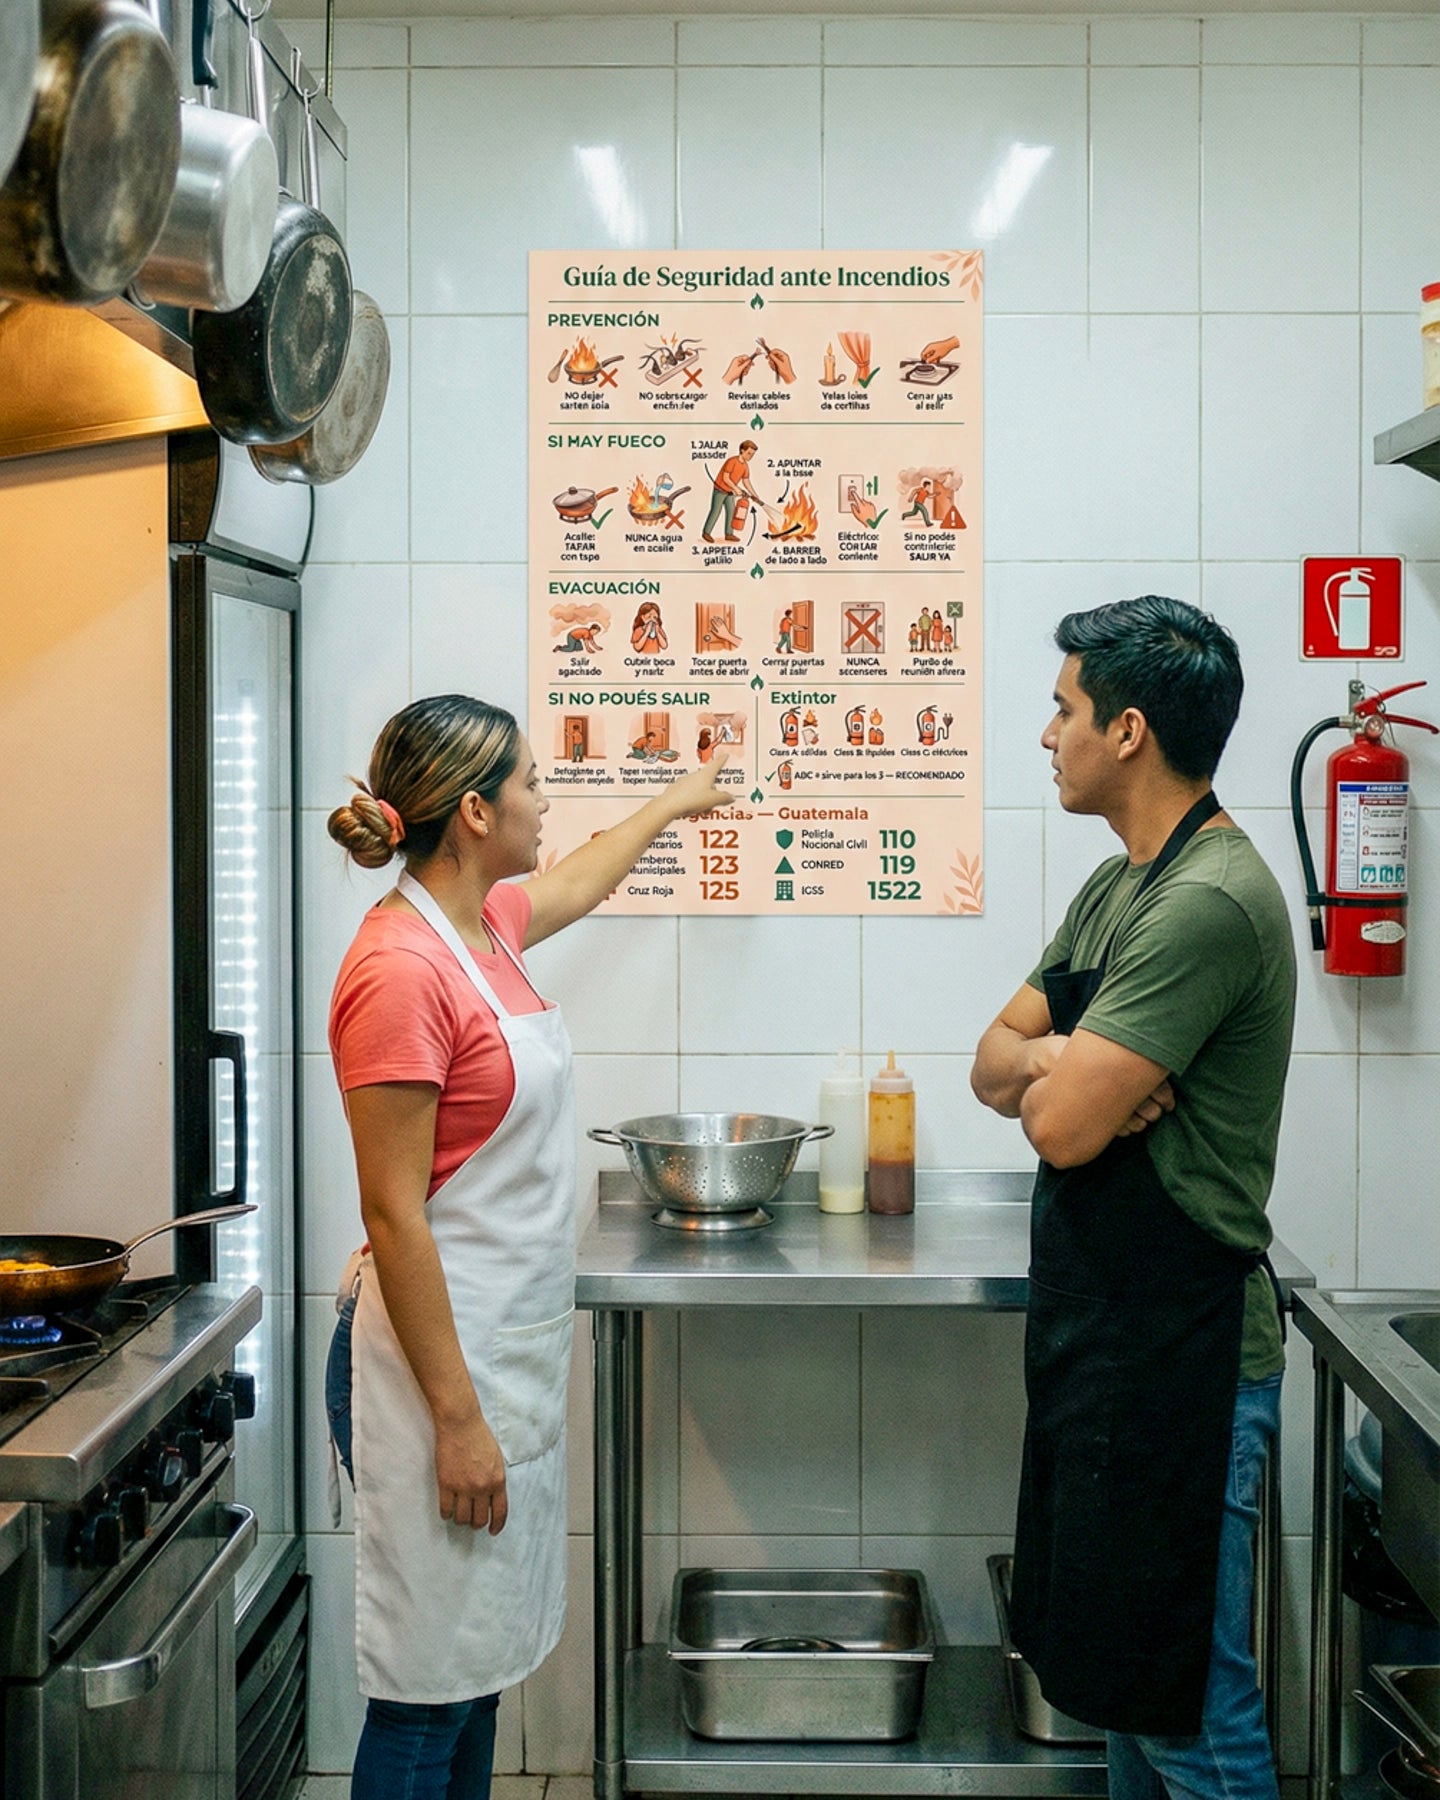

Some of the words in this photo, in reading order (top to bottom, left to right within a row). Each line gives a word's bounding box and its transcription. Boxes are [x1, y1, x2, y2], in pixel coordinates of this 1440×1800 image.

[564, 265, 617, 287] Guía
[622, 266, 651, 287] de
[656, 265, 774, 292] Seguridad
[780, 268, 831, 287] ante
[837, 265, 950, 287] Incendios
[548, 311, 660, 327] PREVENCIÓN
[548, 435, 563, 448] SI
[568, 435, 603, 448] HAY
[625, 534, 658, 543] NUNCA
[549, 578, 660, 594] EVACUACIÓN
[846, 657, 880, 666] NUNCA
[549, 692, 564, 705] SI
[569, 692, 595, 705] NO
[661, 692, 710, 705] SALIR
[771, 690, 837, 704] Extintor
[778, 806, 869, 820] Guatemala
[699, 829, 740, 849] 122
[879, 829, 917, 849] 110
[699, 855, 740, 875] 123
[801, 860, 844, 869] CONRED
[879, 855, 917, 875] 119
[627, 886, 650, 895] Cruz
[652, 886, 674, 897] Roja
[699, 880, 740, 900] 125
[867, 880, 922, 900] 1522
